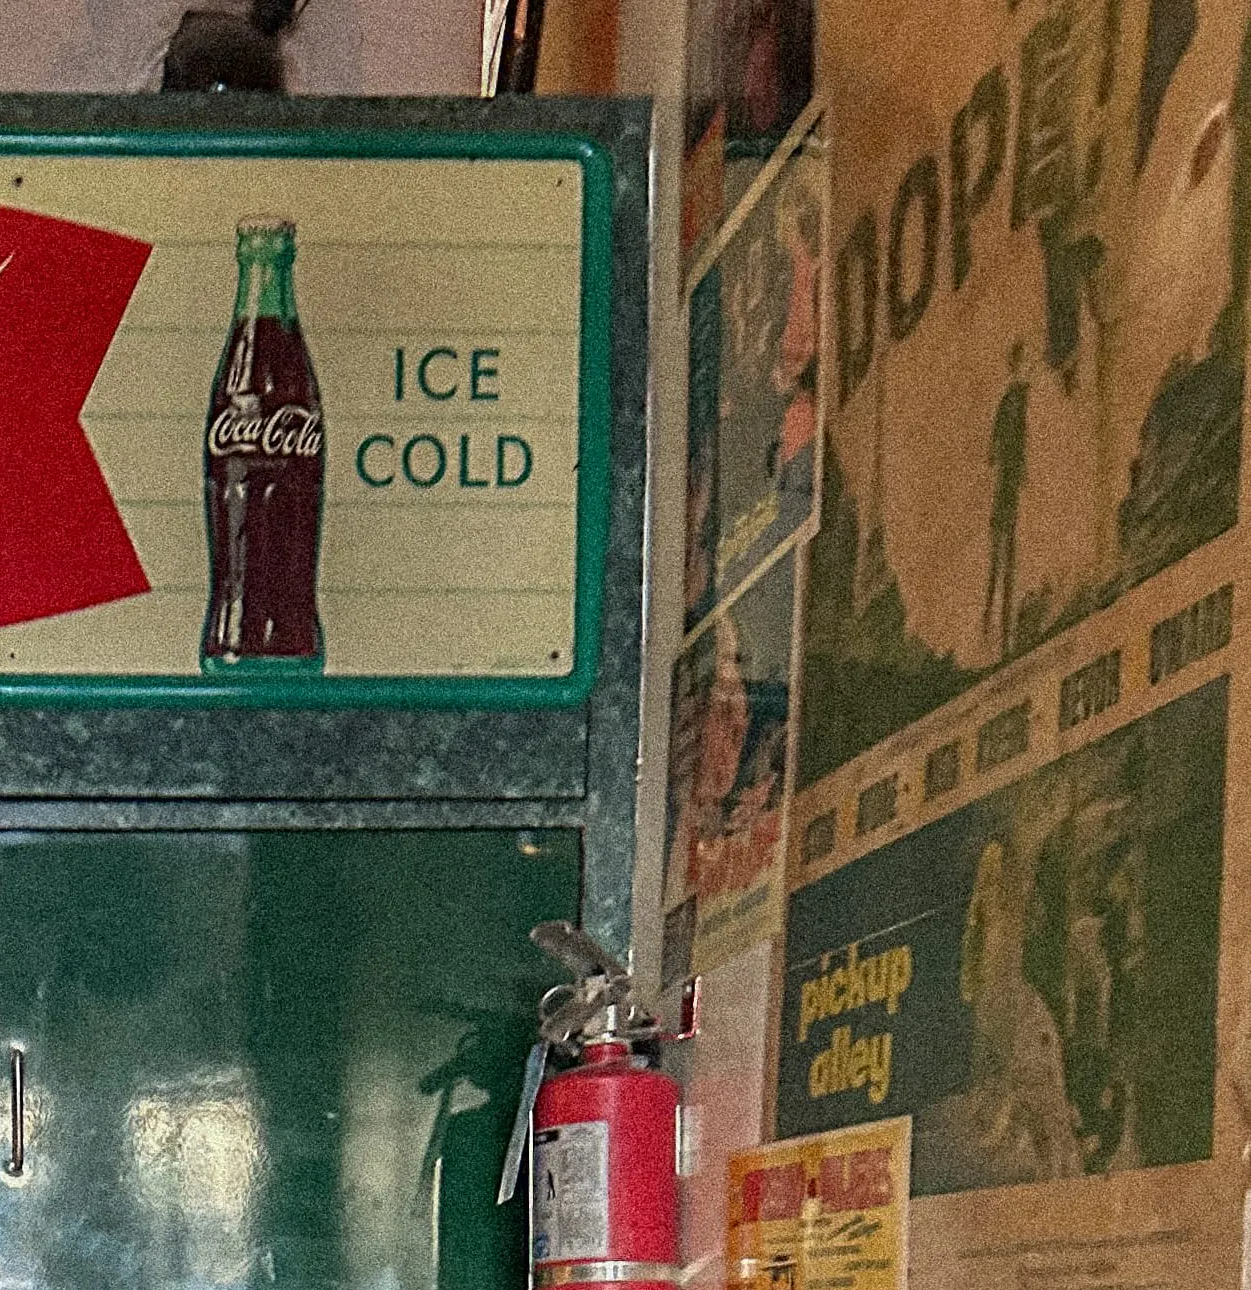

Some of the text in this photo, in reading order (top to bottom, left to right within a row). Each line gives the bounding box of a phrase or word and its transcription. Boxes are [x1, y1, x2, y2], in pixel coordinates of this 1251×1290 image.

[393, 346, 500, 401] ICE
[356, 433, 534, 488] COLD
[797, 941, 913, 1042] pickup
[809, 1025, 894, 1104] alley
